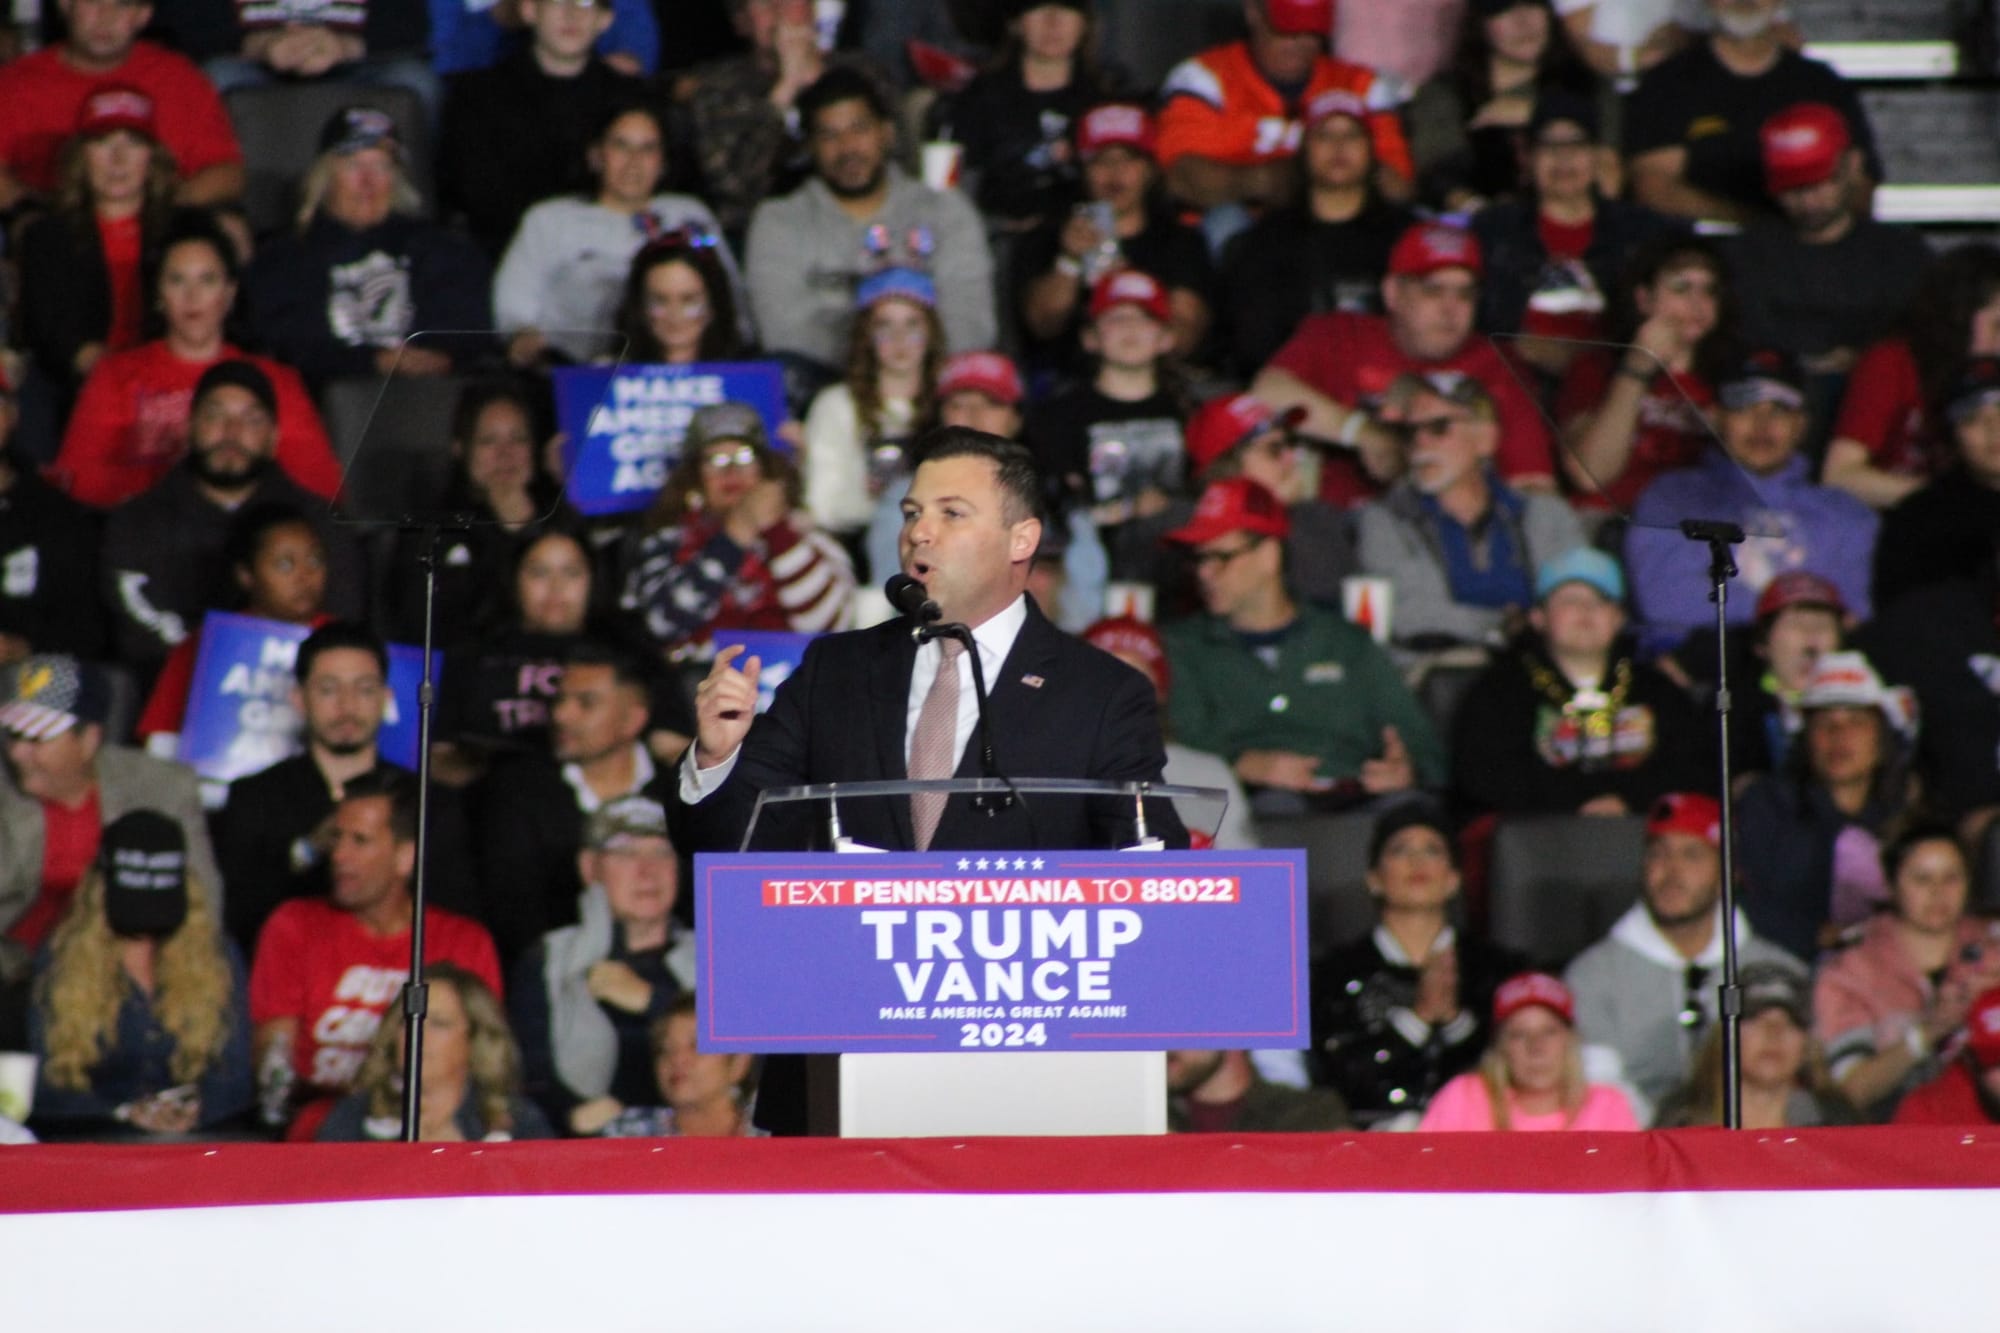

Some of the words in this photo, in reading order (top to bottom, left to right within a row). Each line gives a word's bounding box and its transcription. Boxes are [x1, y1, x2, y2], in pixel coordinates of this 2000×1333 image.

[613, 374, 723, 406] MAKE
[769, 881, 845, 905] TEXT
[853, 879, 1085, 904] PENNSYLVANIA
[1091, 879, 1133, 903] TO
[1140, 878, 1234, 902] 88022
[861, 908, 1143, 960] TRUMP
[893, 960, 1112, 1002] VANCE
[879, 1006, 927, 1020] MAKE
[930, 1006, 1006, 1019] AMERICA
[1010, 1006, 1064, 1019] GREAT
[1068, 1005, 1128, 1018] AGAIN!
[960, 1022, 1047, 1047] 2024
